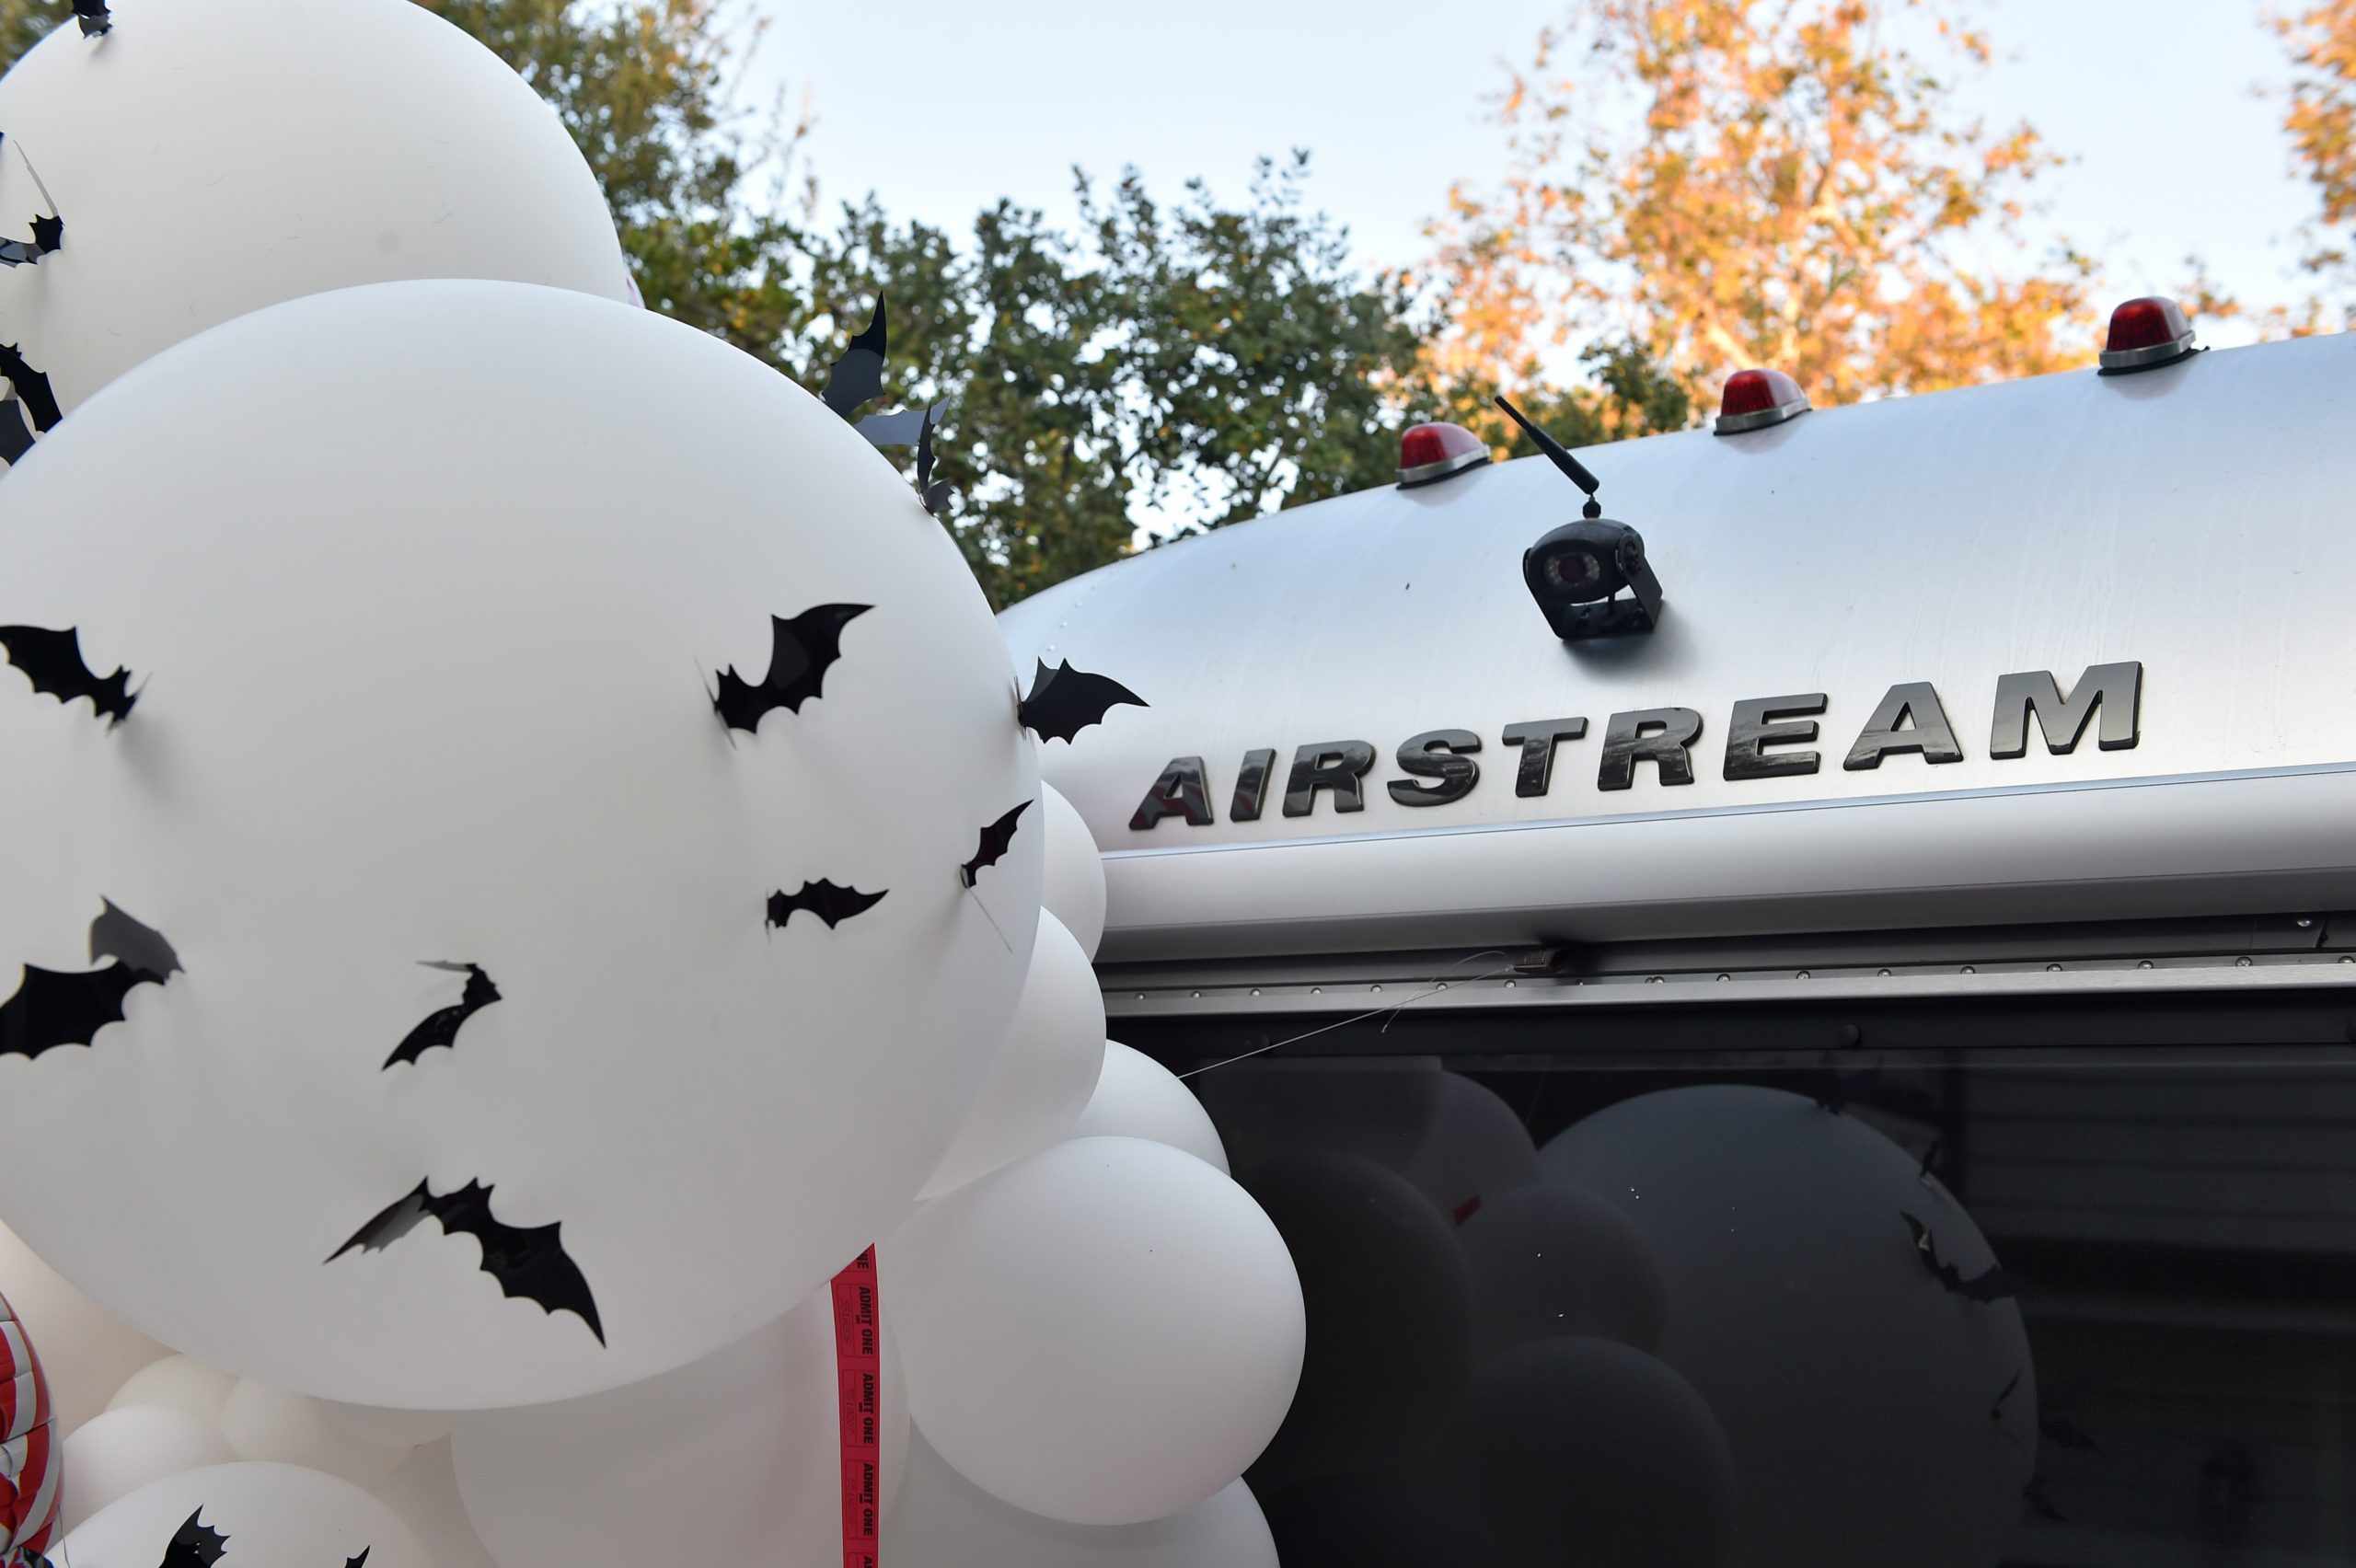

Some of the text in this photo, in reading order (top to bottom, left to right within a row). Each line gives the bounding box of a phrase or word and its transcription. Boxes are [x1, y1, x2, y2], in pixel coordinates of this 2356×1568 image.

[1129, 661, 2143, 829] AIRSTREAM
[859, 1286, 873, 1355] ADMIT ONE
[862, 1373, 874, 1444] ADMIT ONE
[863, 1462, 873, 1536] ADMIT ONE
